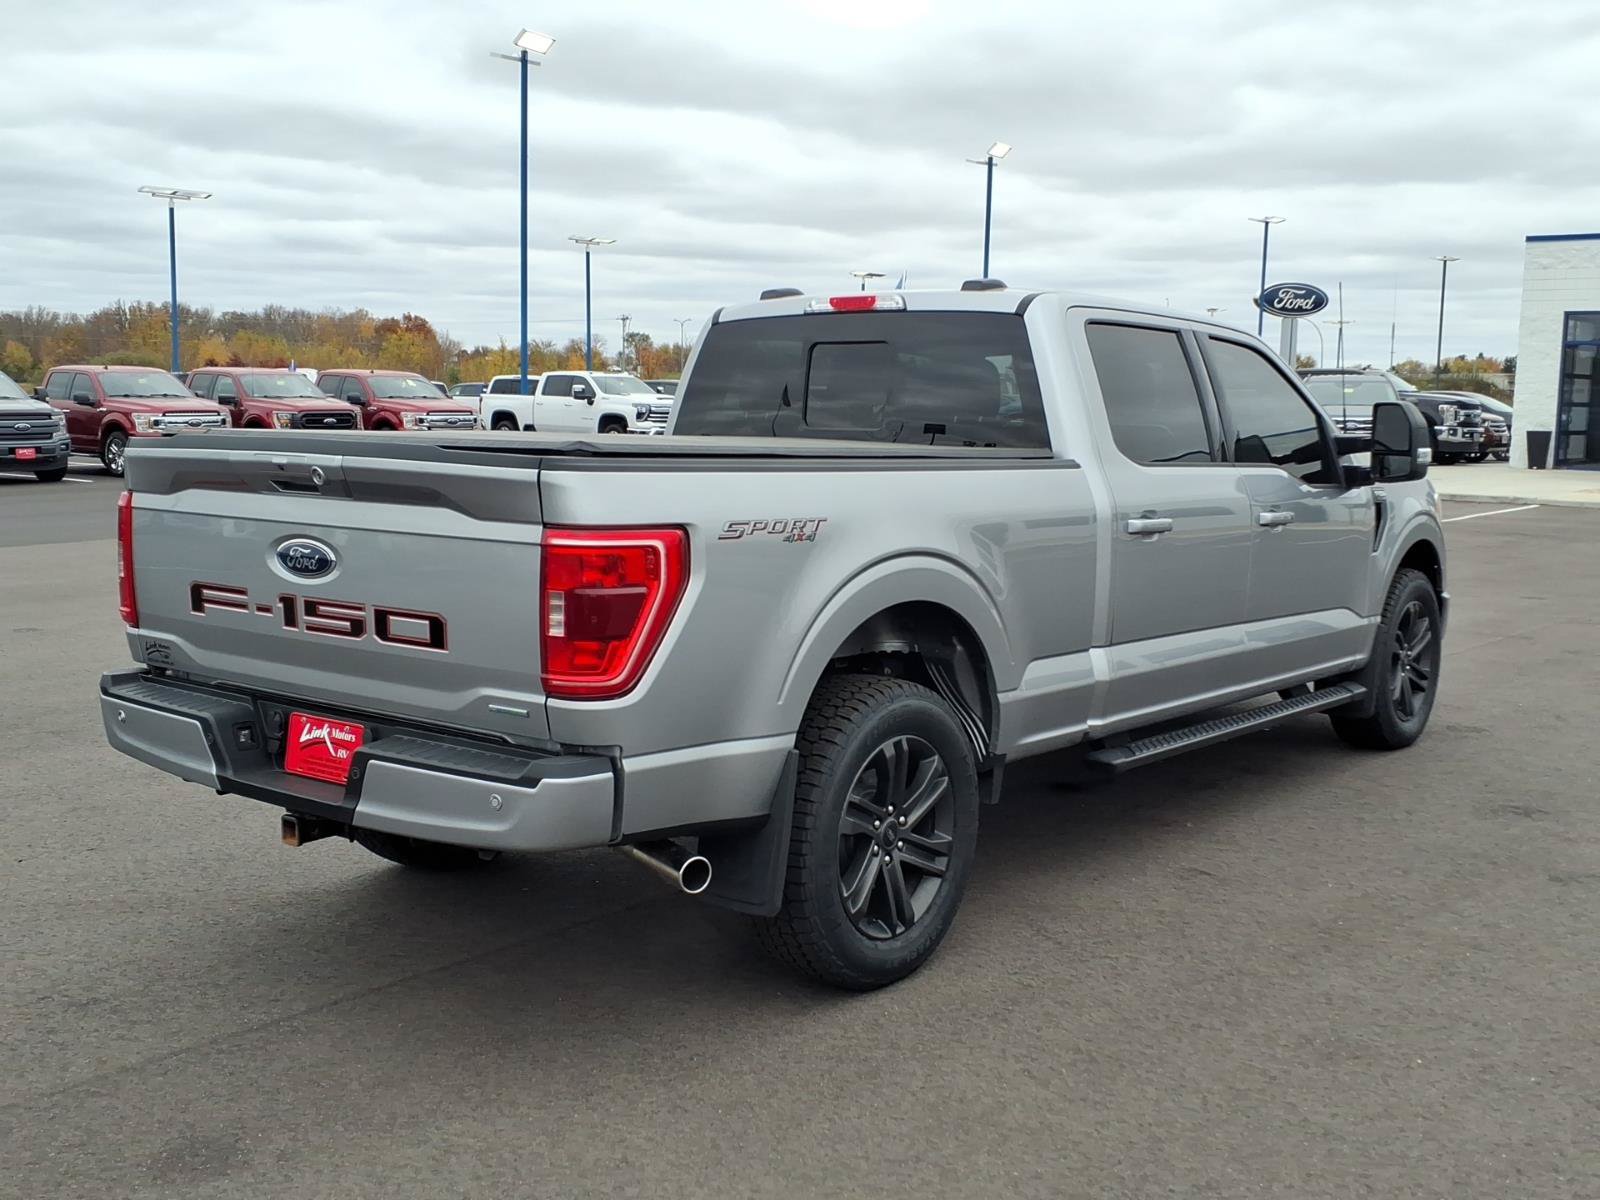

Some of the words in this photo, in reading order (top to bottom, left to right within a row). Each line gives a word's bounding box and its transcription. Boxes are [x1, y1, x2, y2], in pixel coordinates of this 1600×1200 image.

[1274, 288, 1316, 309] Ford
[718, 518, 827, 540] SPORT
[287, 546, 320, 569] Ford
[190, 581, 448, 653] F-150
[299, 723, 336, 757] Link
[330, 728, 356, 742] Motors
[337, 748, 349, 759] RV
